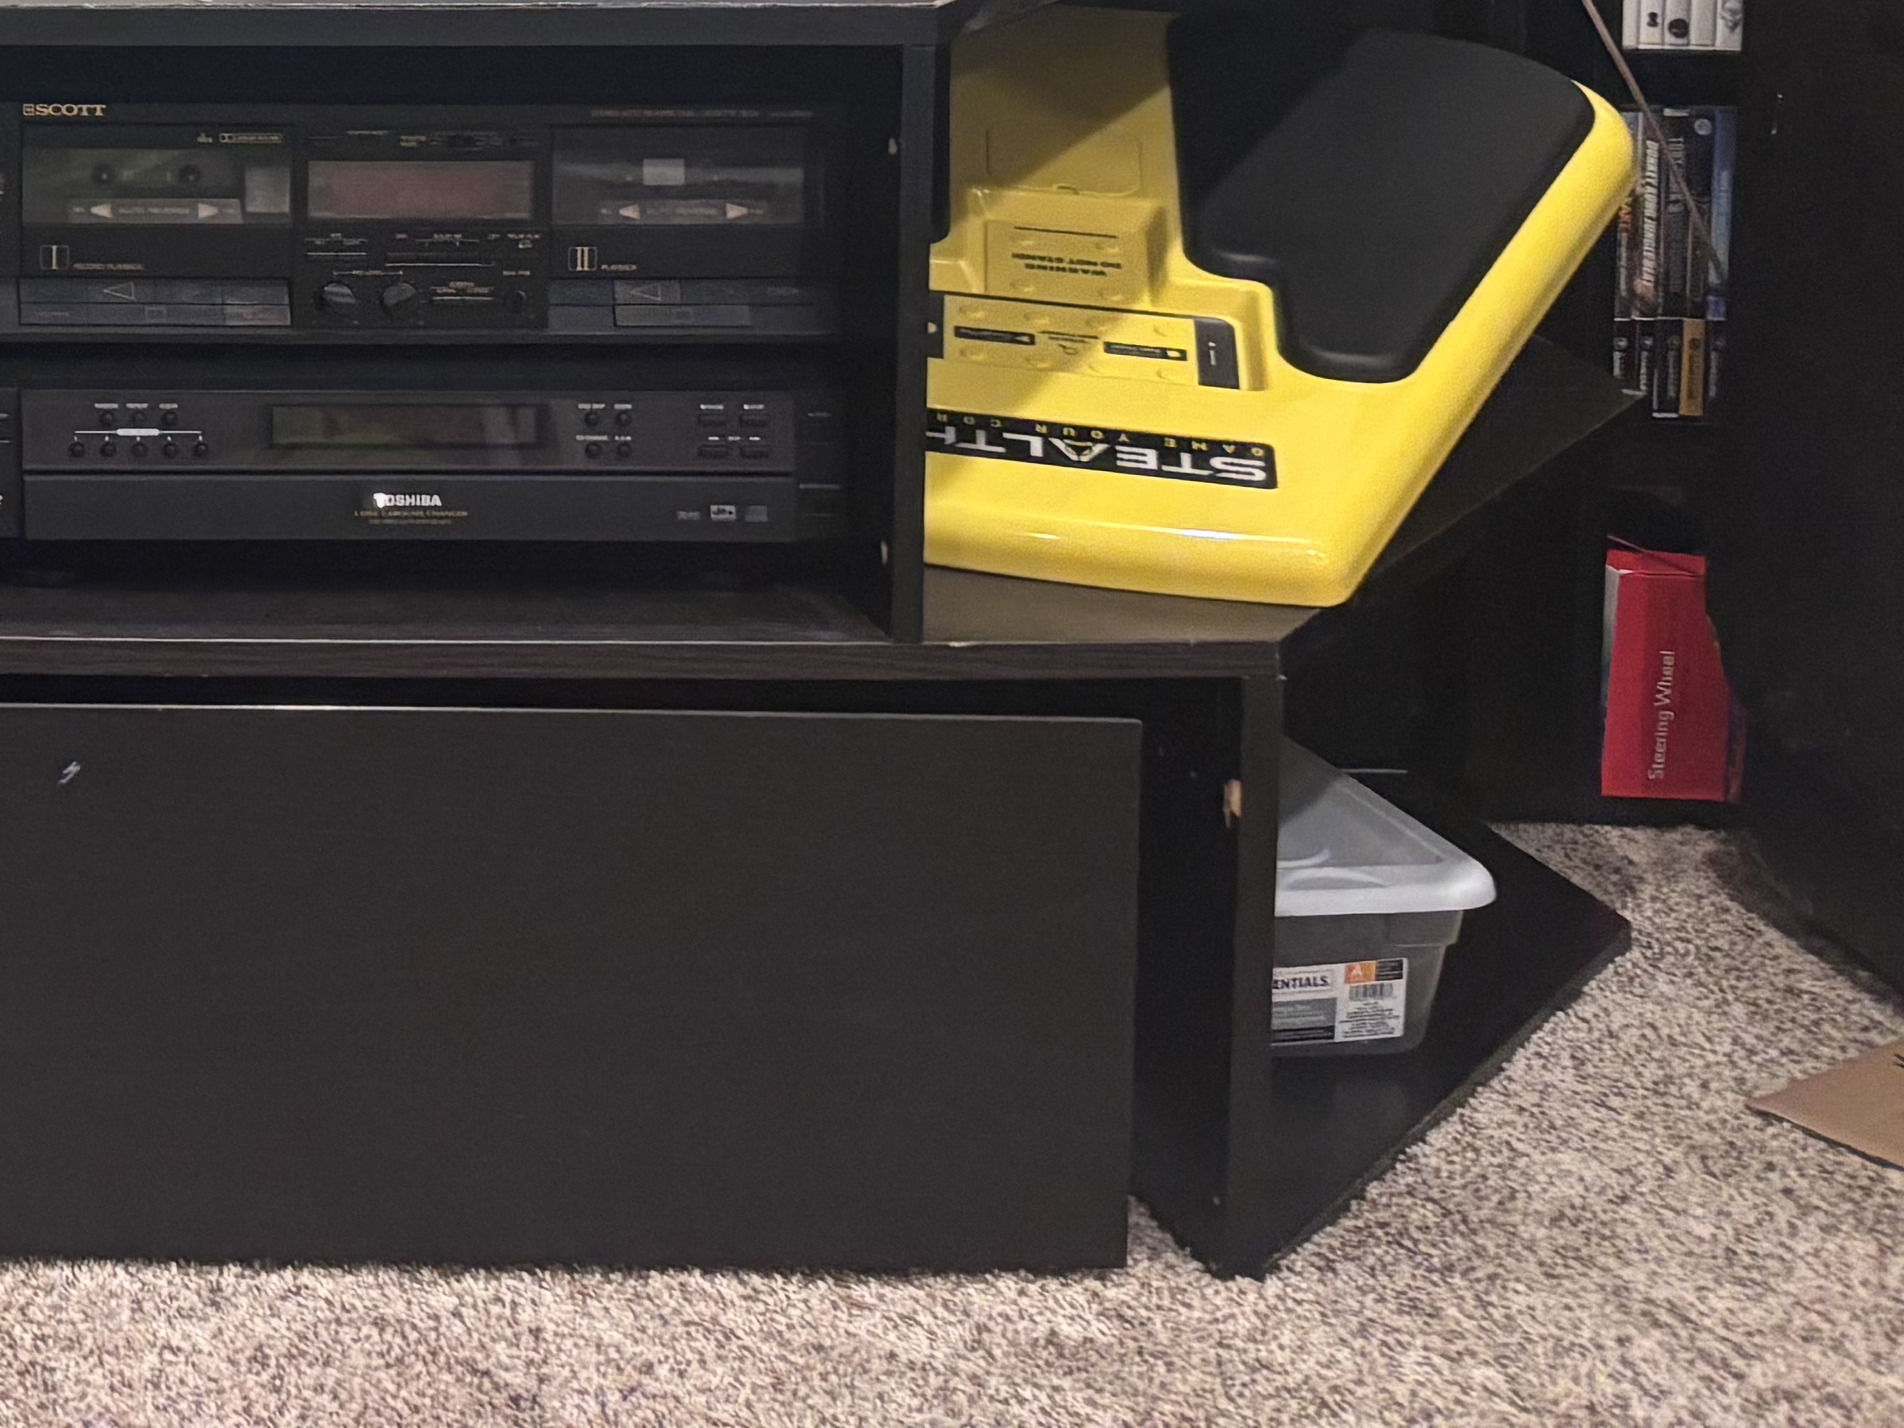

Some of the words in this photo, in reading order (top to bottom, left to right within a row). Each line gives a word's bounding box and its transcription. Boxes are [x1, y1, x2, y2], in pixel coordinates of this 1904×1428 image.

[34, 104, 106, 116] SCOTT
[1654, 650, 1675, 707] Wheel
[1648, 710, 1674, 779] Steering
